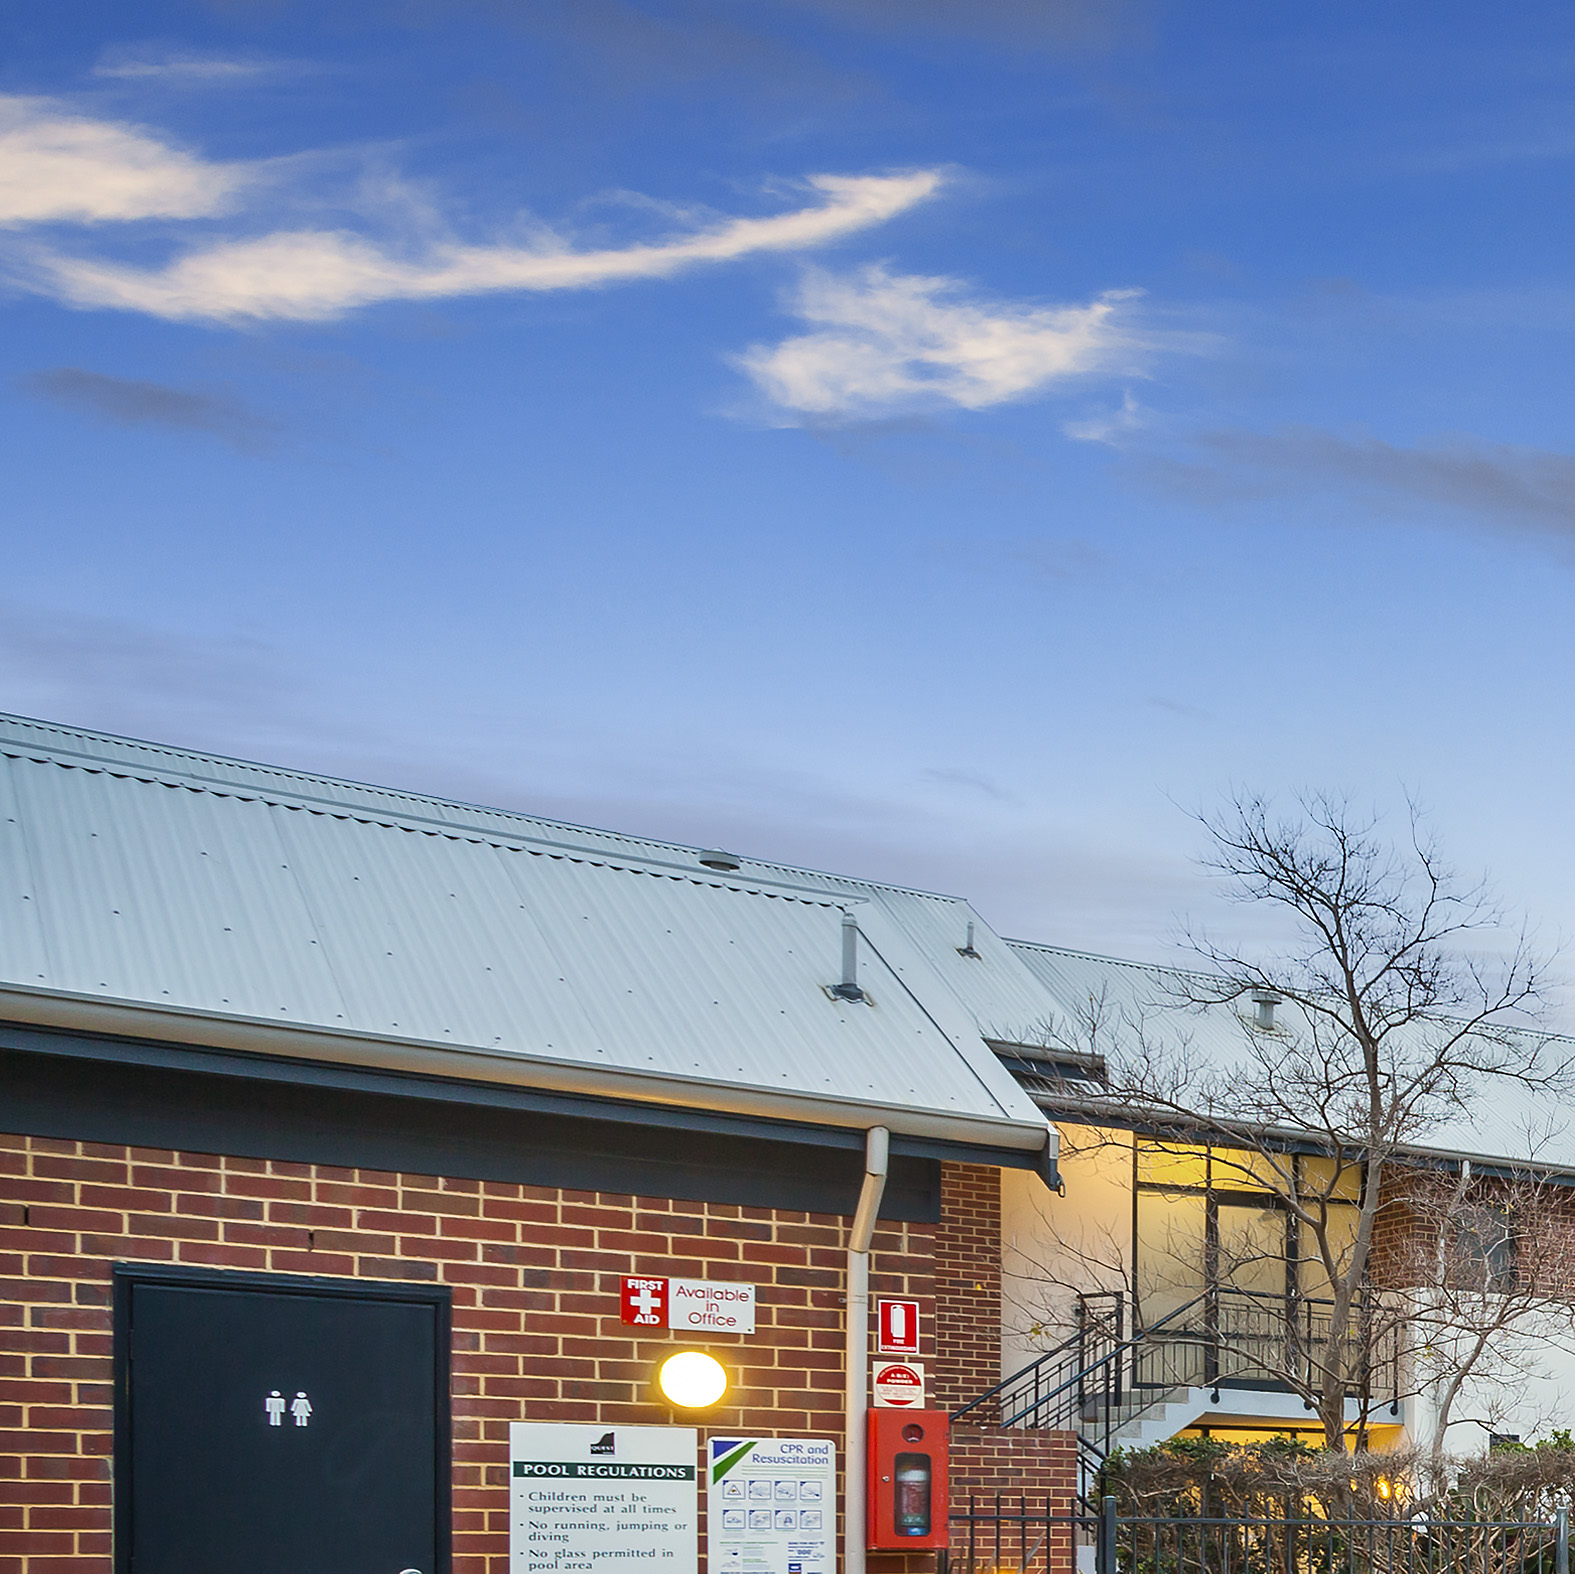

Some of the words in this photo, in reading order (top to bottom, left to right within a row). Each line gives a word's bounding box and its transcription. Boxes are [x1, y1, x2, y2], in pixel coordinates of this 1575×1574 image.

[627, 1279, 664, 1291] FIRST
[676, 1285, 749, 1302] Available
[706, 1300, 719, 1312] in
[633, 1314, 660, 1325] AID
[688, 1312, 736, 1327] Office
[780, 1444, 804, 1454] CPR
[807, 1444, 829, 1455] and
[752, 1454, 829, 1465] Resuscitation
[523, 1464, 570, 1476] POOL
[577, 1465, 687, 1478] REGULATIONS
[528, 1491, 587, 1502] Children
[593, 1494, 625, 1502] must
[631, 1492, 647, 1502] be
[528, 1503, 598, 1514] supervised
[603, 1505, 615, 1513] at
[621, 1504, 637, 1514] all
[643, 1505, 677, 1514] times
[529, 1521, 548, 1529] No
[554, 1521, 610, 1531] running,
[616, 1521, 669, 1532] jumping
[674, 1522, 688, 1530] or
[528, 1532, 570, 1543] diving
[529, 1549, 548, 1558] No
[555, 1549, 586, 1559] glass
[592, 1549, 656, 1560] permitted
[662, 1549, 674, 1558] in
[528, 1560, 559, 1572] pool
[564, 1562, 593, 1570] area
